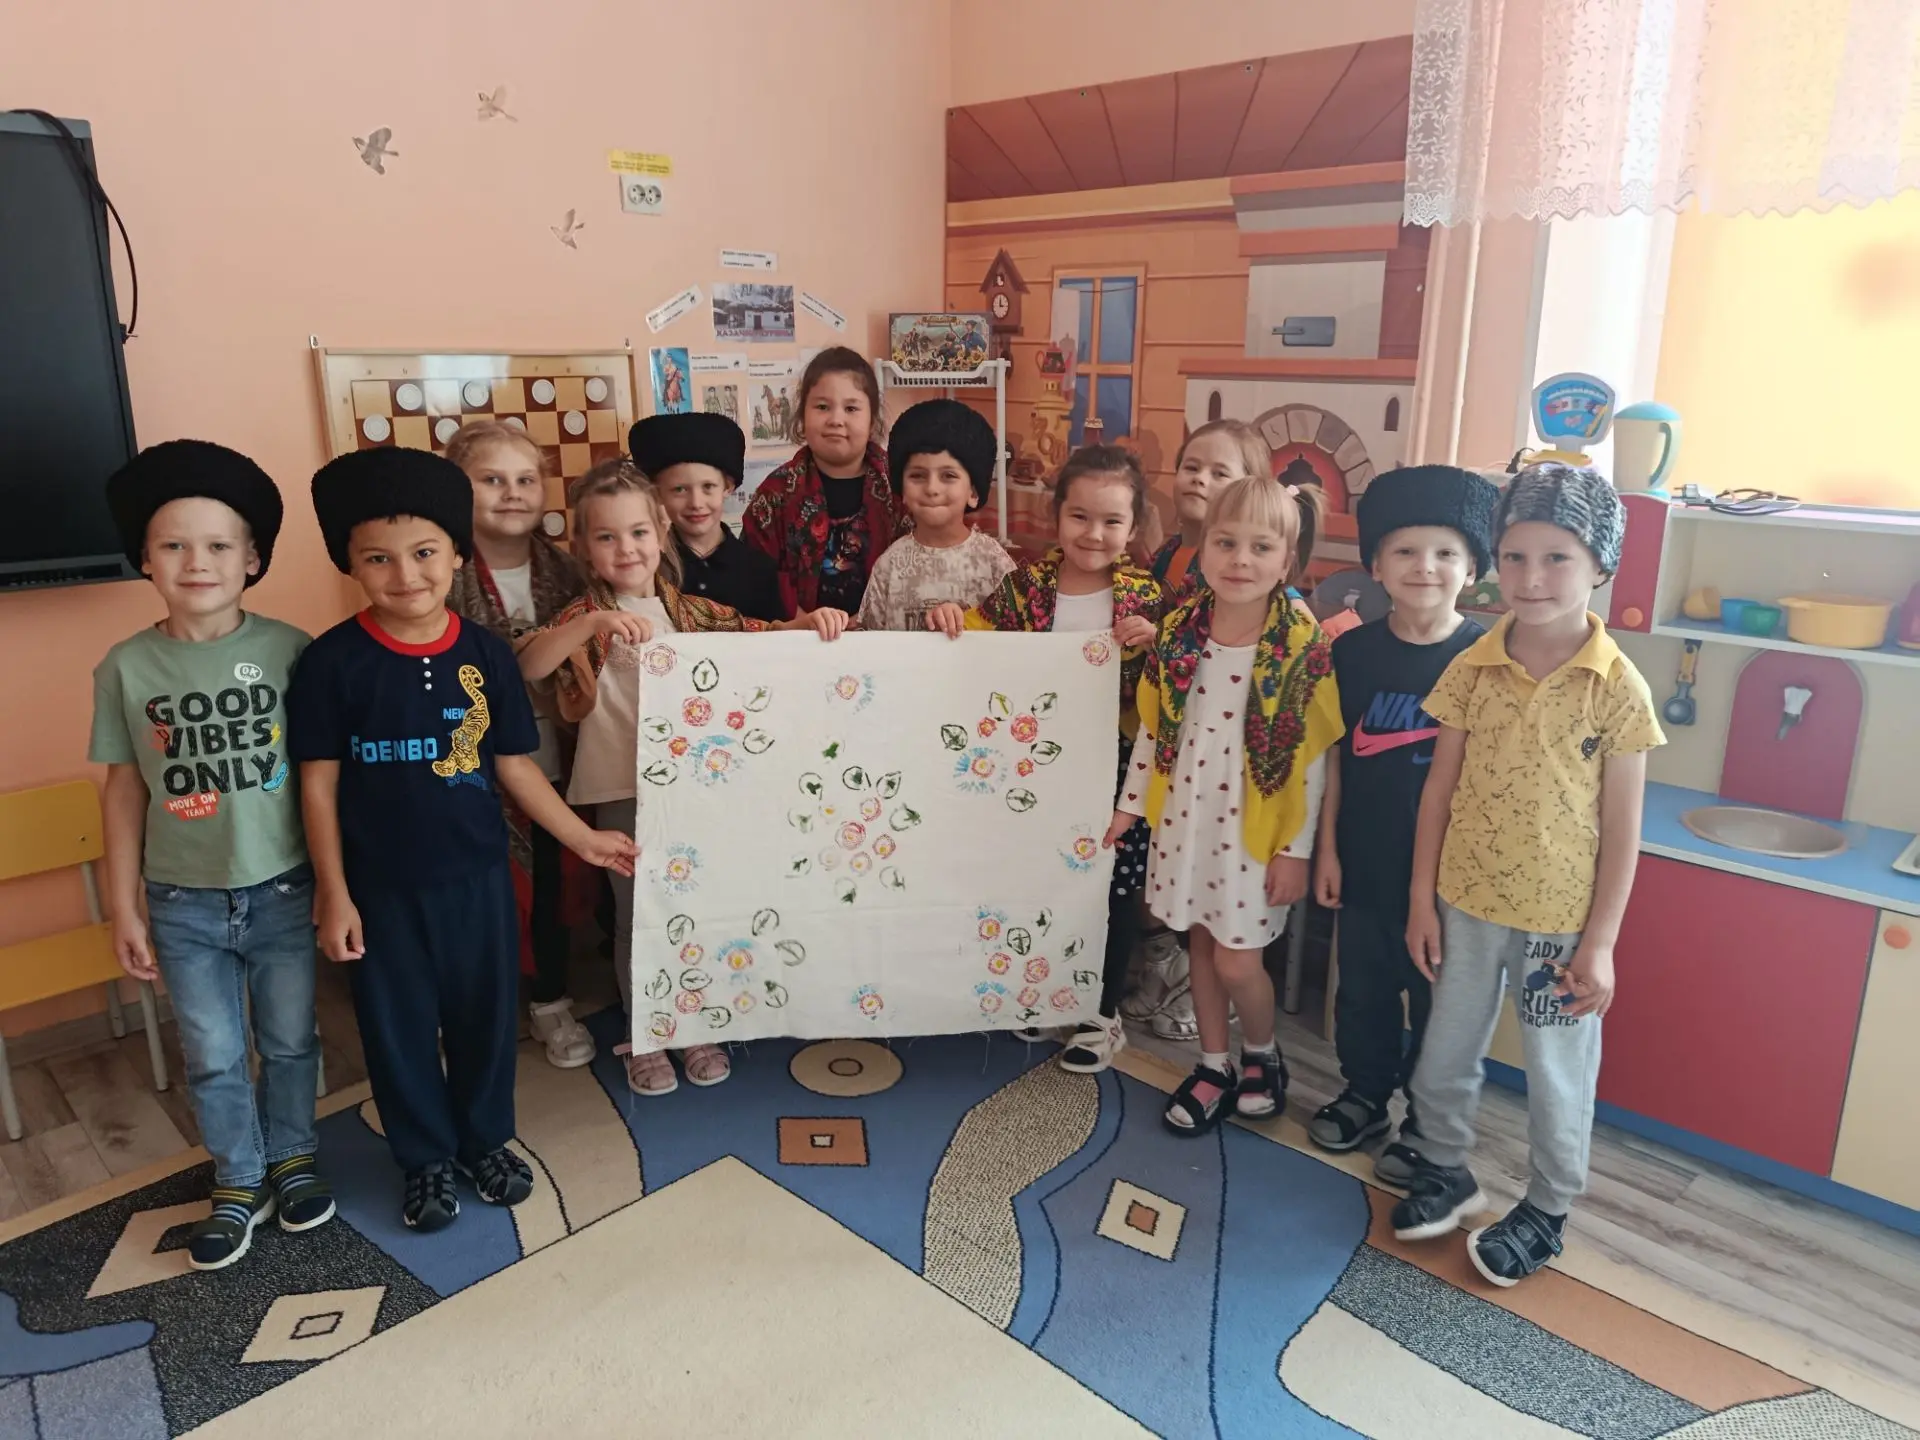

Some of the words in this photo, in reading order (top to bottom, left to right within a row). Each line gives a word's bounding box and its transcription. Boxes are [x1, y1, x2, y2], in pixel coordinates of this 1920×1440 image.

[241, 666, 260, 678] OK
[145, 684, 278, 727] GOOD
[156, 716, 272, 759] VIBES
[163, 751, 278, 796] ONLY
[168, 797, 197, 811] MOVE
[200, 792, 217, 804] ON
[1524, 940, 1564, 960] EADY
[1522, 1013, 1579, 1029] ERGARTEN
